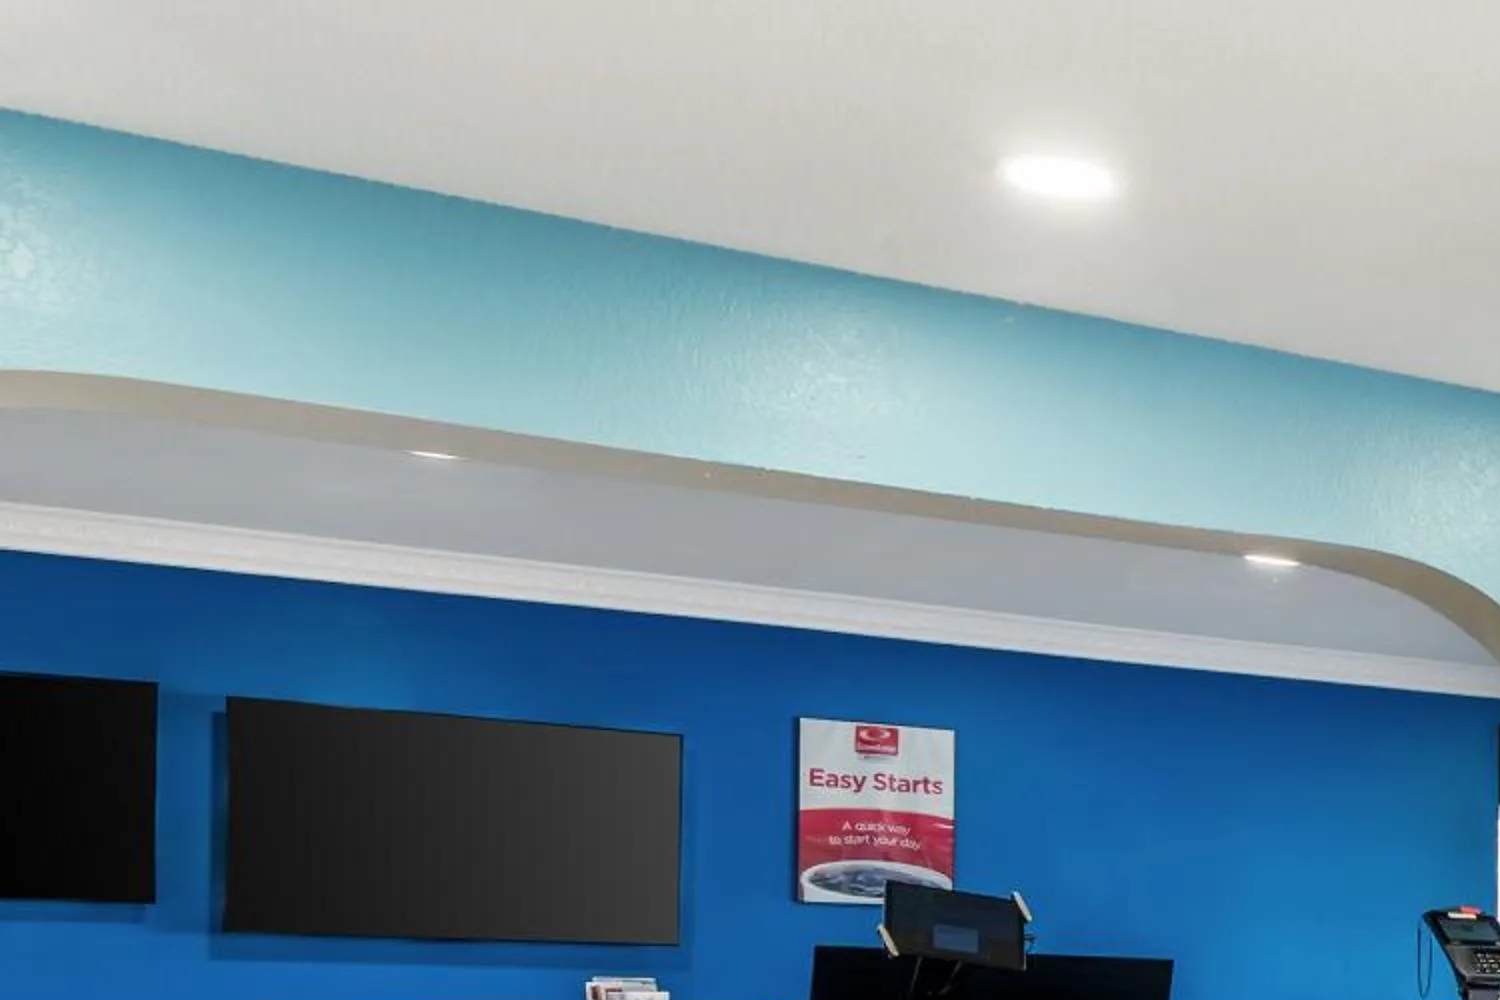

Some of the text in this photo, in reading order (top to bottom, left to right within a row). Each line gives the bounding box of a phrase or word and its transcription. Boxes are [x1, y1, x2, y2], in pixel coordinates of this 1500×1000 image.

[809, 767, 944, 795] Easy Starts
[841, 820, 911, 836] A quick way
[829, 835, 842, 845] to
[843, 835, 870, 846] start
[873, 836, 898, 848] your
